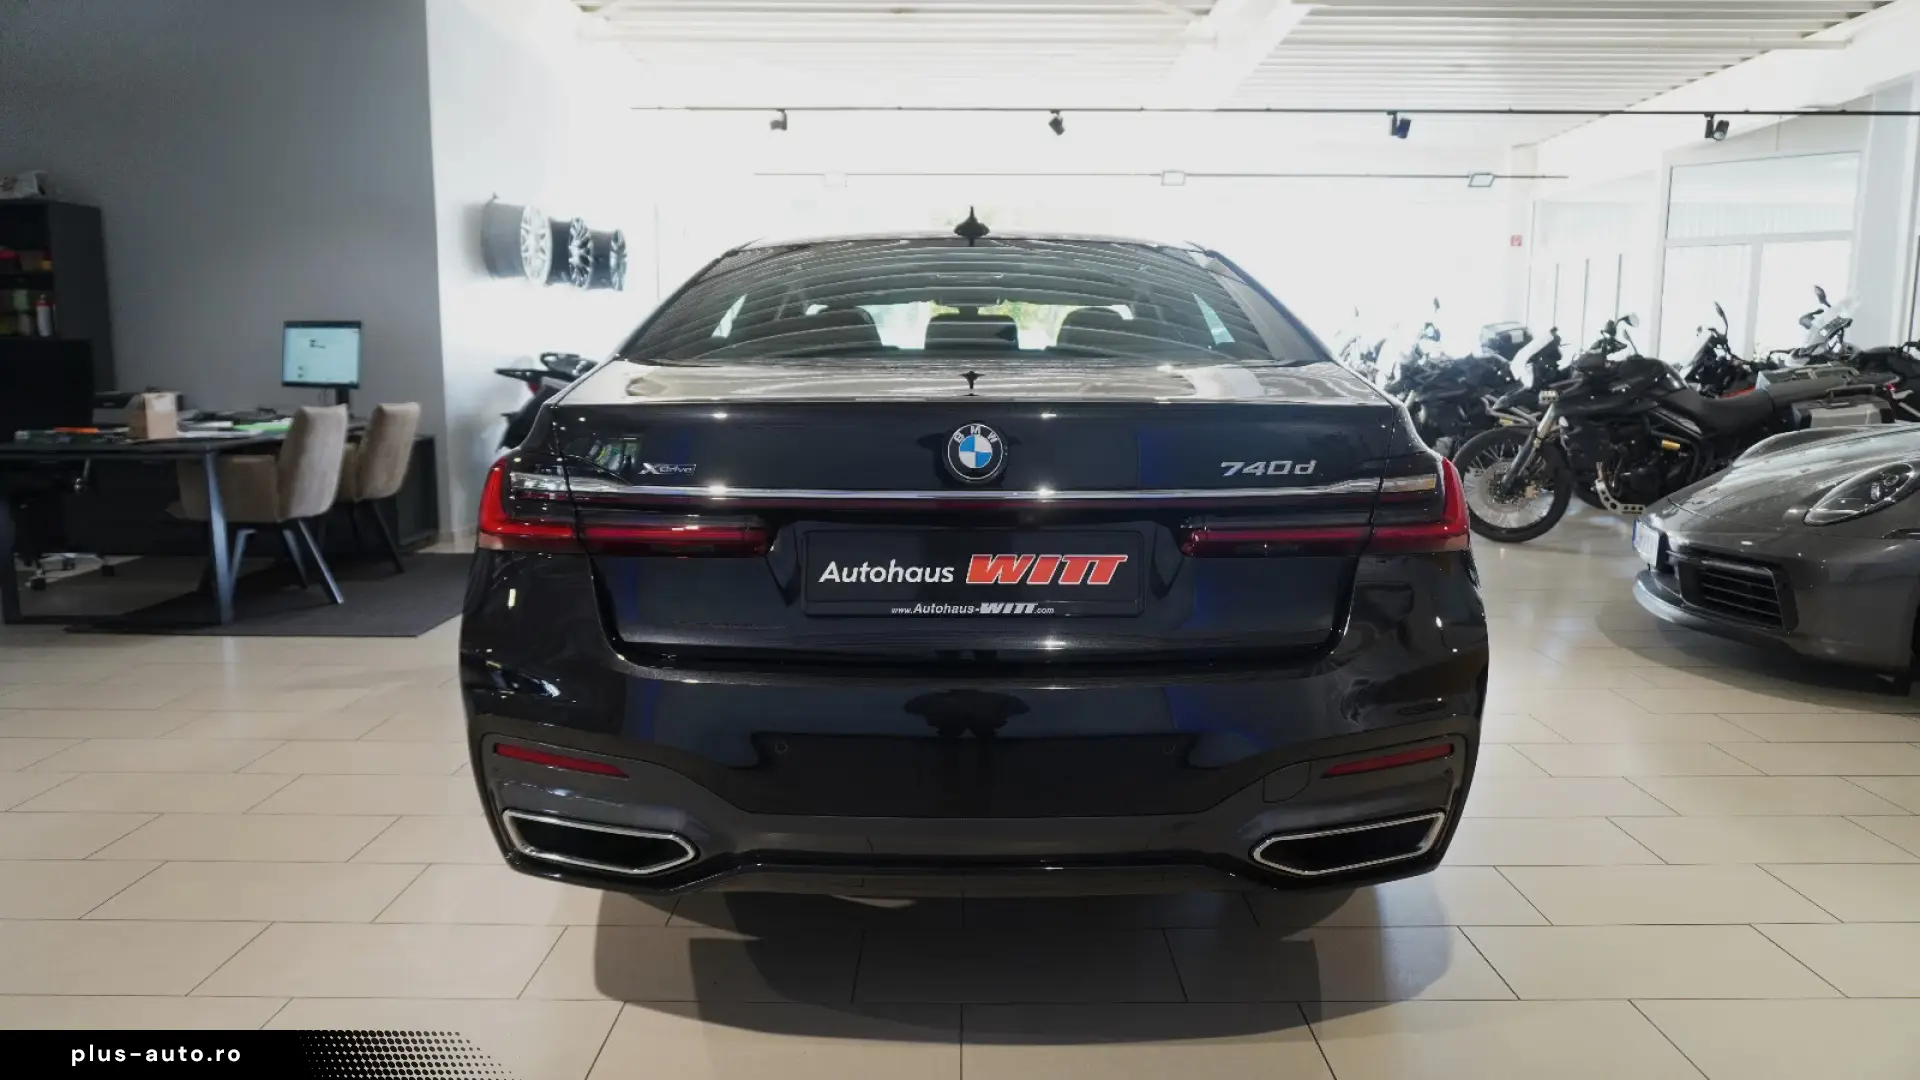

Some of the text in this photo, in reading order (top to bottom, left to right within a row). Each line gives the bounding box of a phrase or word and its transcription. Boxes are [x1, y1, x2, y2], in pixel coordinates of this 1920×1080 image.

[953, 425, 998, 444] BMW
[1220, 459, 1317, 476] 740d
[818, 554, 1128, 585] Autohaus WITT
[891, 602, 1054, 614] www.Autohaus-WITT.com
